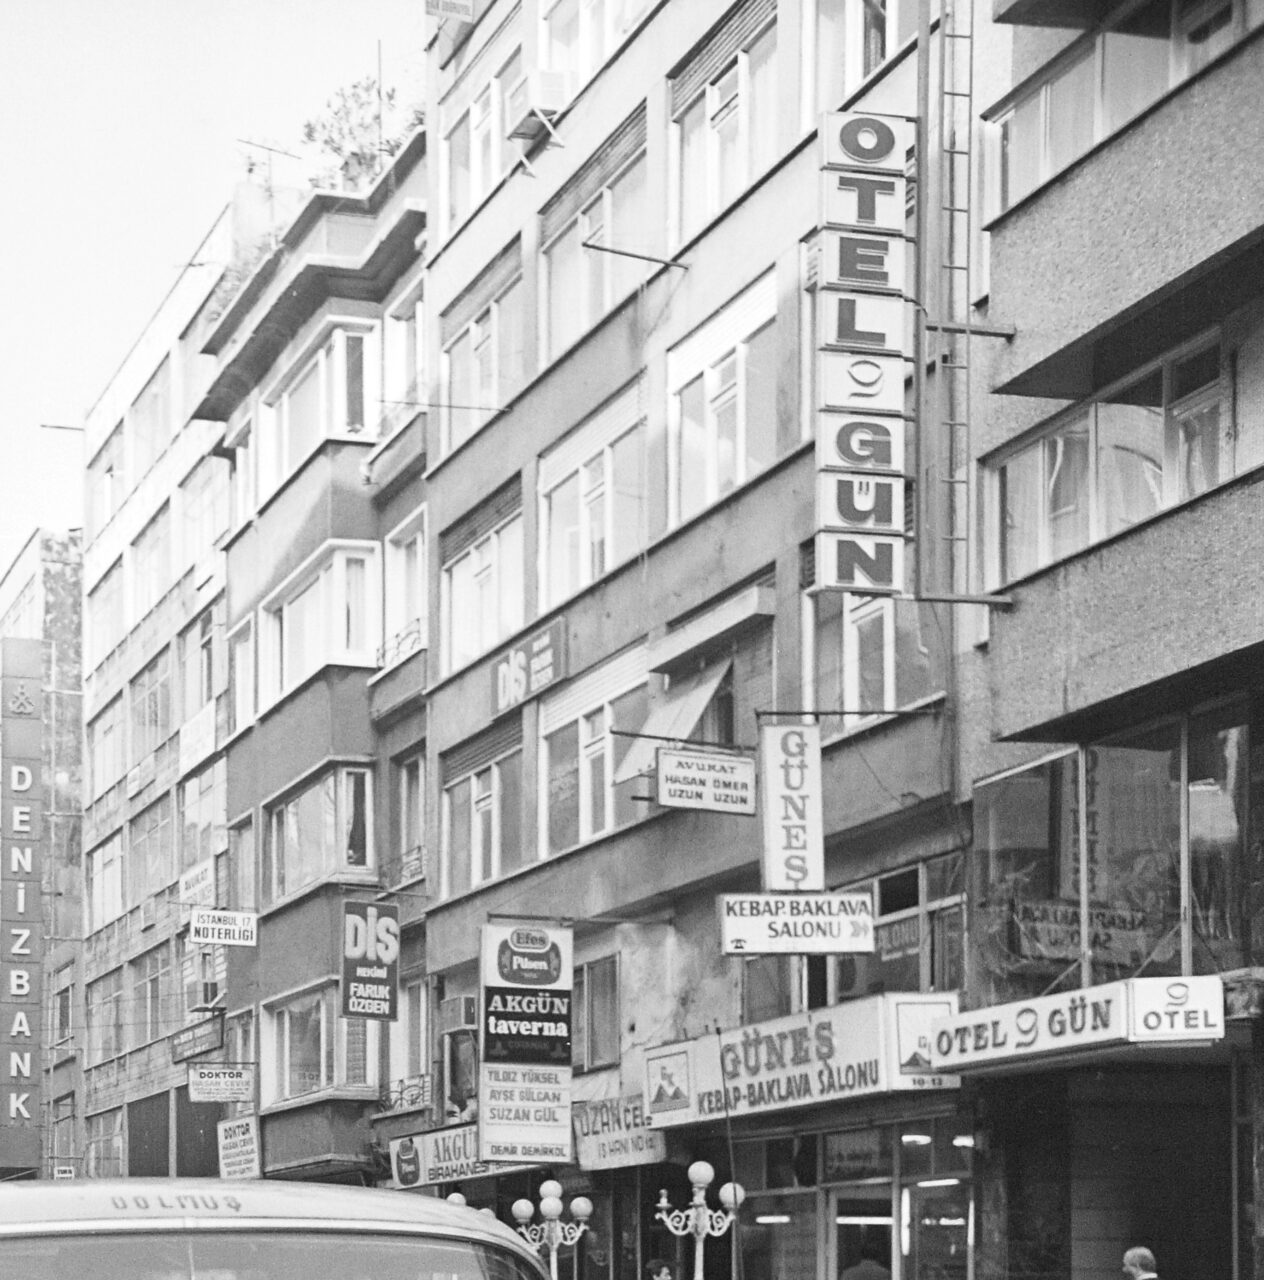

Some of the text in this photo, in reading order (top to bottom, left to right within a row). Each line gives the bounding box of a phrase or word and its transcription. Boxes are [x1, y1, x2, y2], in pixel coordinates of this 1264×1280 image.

[837, 117, 896, 345] OTEL
[835, 421, 893, 586] GÜN
[676, 761, 736, 774] AVUKAT
[665, 775, 748, 791] HASAN ÖMER
[668, 788, 748, 804] UZUN UZUN
[780, 730, 810, 889] GÜNEŞ
[242, 916, 251, 927] 17
[768, 921, 841, 939] SALONU
[9, 764, 33, 1120] DENİZBANK
[344, 906, 399, 965] DİŞ
[516, 931, 546, 946] Efes
[350, 982, 390, 1000] FARUK
[348, 995, 390, 1014] ÖZGEN
[488, 992, 569, 1015] AKGÜN
[488, 1015, 569, 1037] taverna
[937, 1019, 1008, 1057] OTEL
[1047, 996, 1114, 1038] GÜN
[1142, 1010, 1218, 1032] OTEL
[721, 1020, 836, 1080] GÜNEŞ
[199, 1071, 243, 1079] DOKTOR
[488, 1069, 561, 1084] YILDIZ YÜKSEL
[818, 1059, 880, 1097] SALONU
[489, 1106, 559, 1122] SUZAN GÜL
[223, 1122, 250, 1140] DOKTOR
